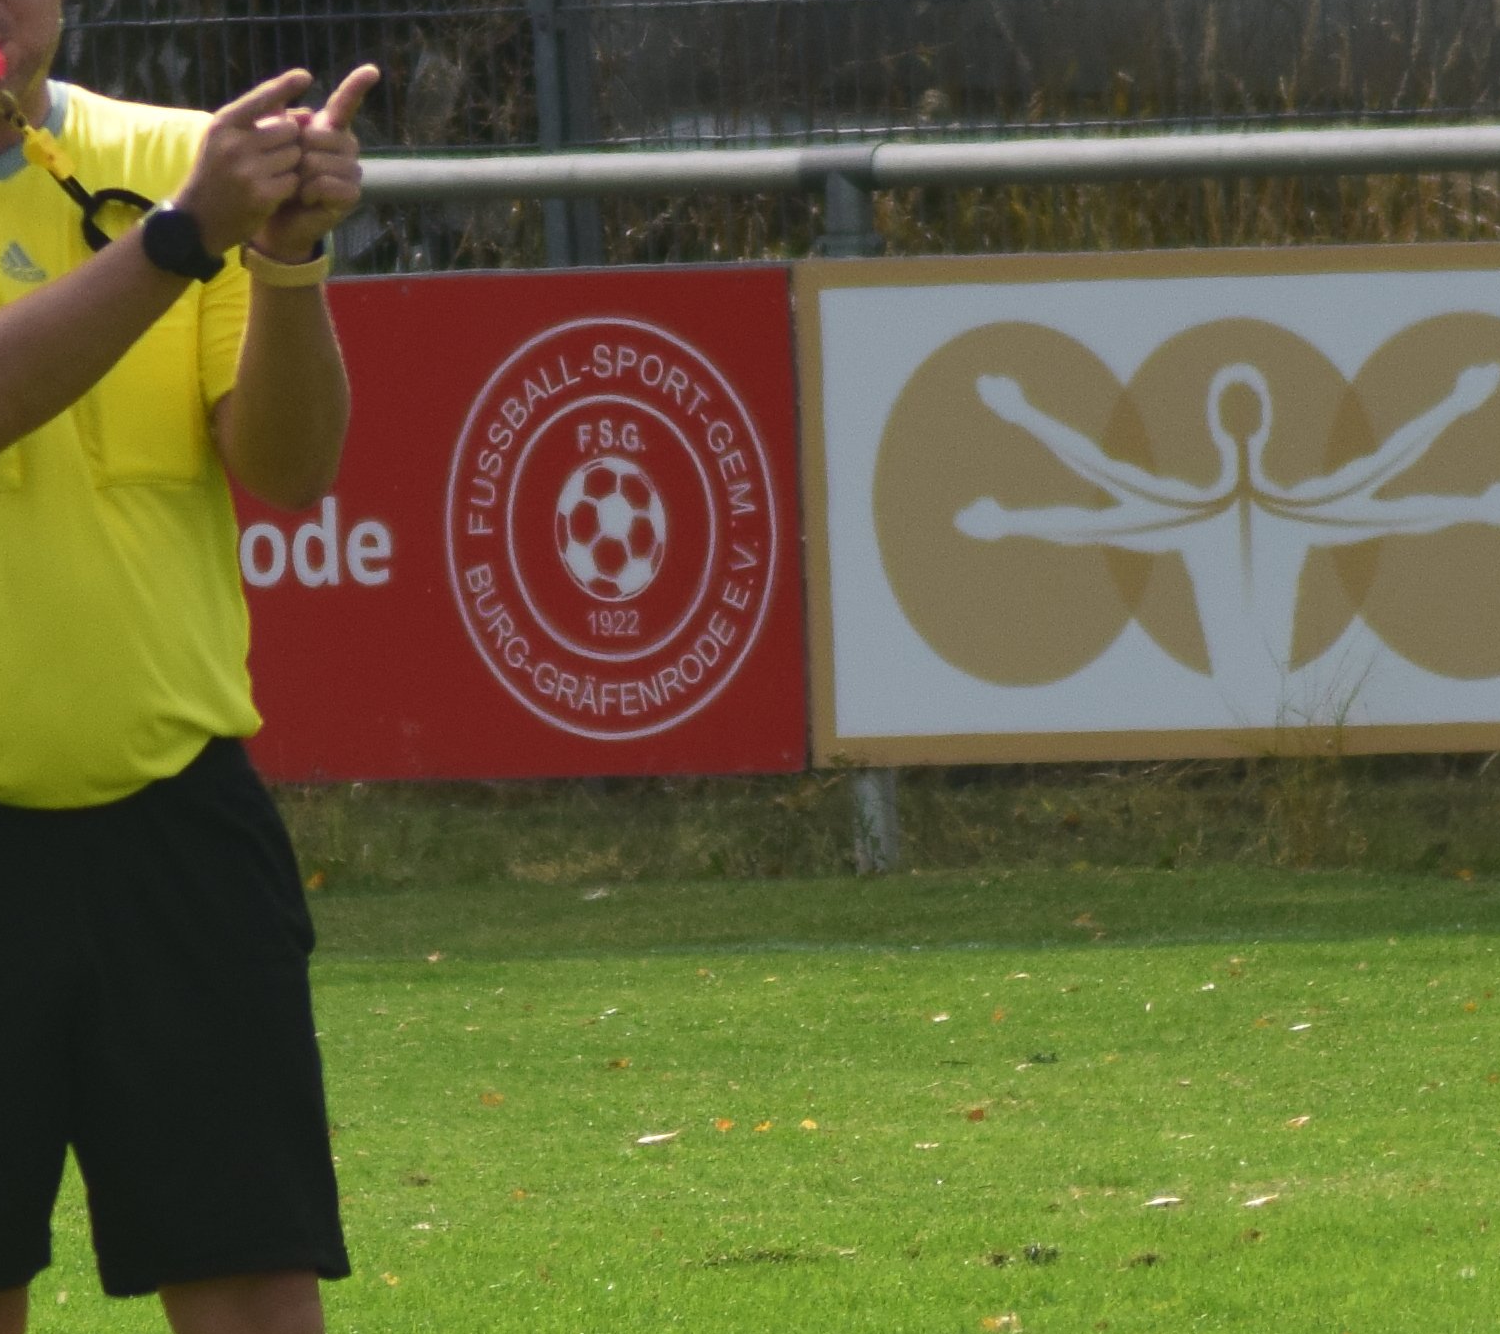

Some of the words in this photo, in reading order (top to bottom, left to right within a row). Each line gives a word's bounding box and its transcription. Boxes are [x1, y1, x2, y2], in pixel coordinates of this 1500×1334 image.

[467, 344, 758, 536] FUSSBALL-SPORT-GEM.
[576, 420, 647, 454] F.S.G.
[465, 561, 738, 717] BURG-GRÄFENRODE
[587, 610, 640, 637] 1922
